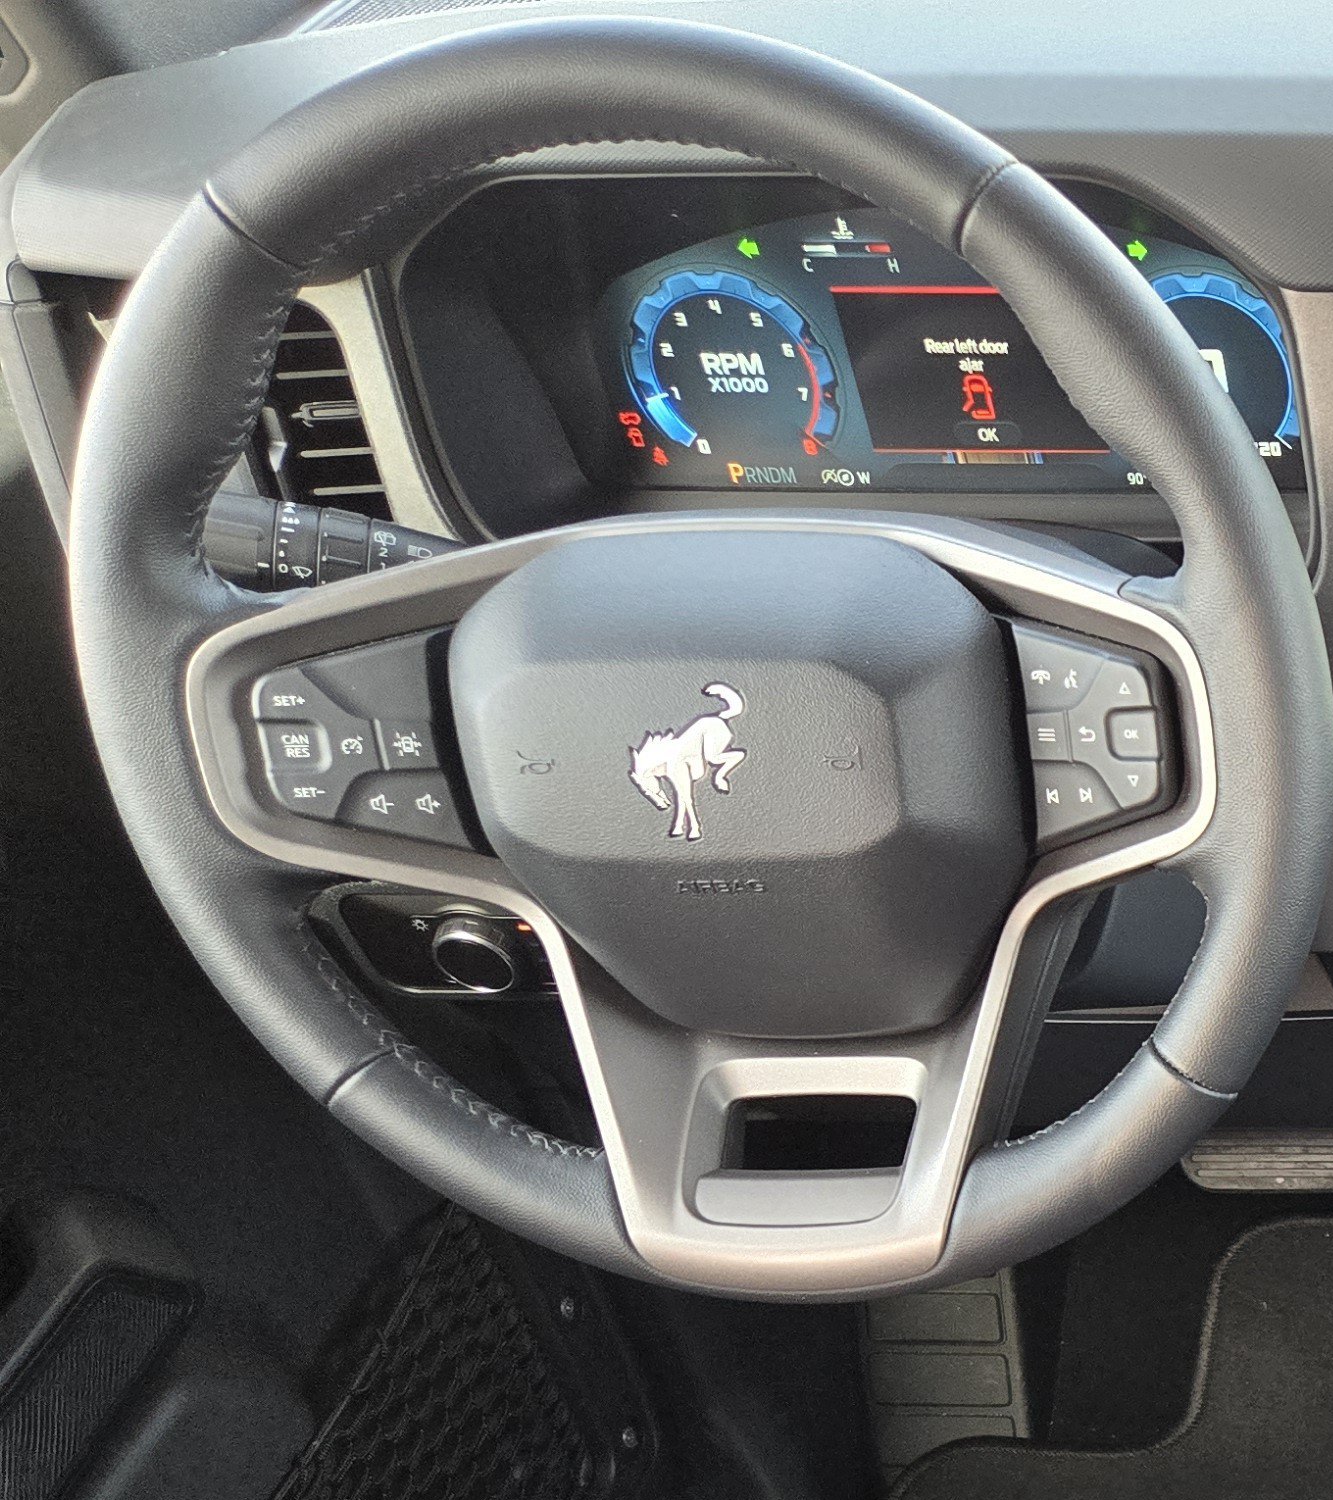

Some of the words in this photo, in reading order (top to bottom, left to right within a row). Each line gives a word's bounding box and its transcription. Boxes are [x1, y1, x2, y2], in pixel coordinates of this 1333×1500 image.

[802, 258, 814, 273] C
[887, 258, 900, 273] H
[706, 299, 722, 315] 4
[672, 312, 688, 328] 3
[750, 312, 764, 328] 5
[660, 343, 675, 358] 2
[781, 343, 795, 358] 6
[923, 338, 954, 354] Rear
[956, 339, 979, 354] left
[980, 340, 1008, 354] door
[700, 352, 766, 376] RPM
[958, 358, 984, 374] ajar
[710, 378, 769, 394] X1000
[670, 387, 682, 401] 1
[797, 387, 809, 402] 7
[978, 428, 1000, 443] OK
[696, 439, 712, 454] 0
[1254, 442, 1282, 456] 20
[858, 472, 871, 484] W
[379, 547, 388, 558] 2
[273, 695, 306, 707] SET+
[281, 734, 310, 746] CAN
[1124, 729, 1140, 740] OK
[285, 748, 310, 758] RES
